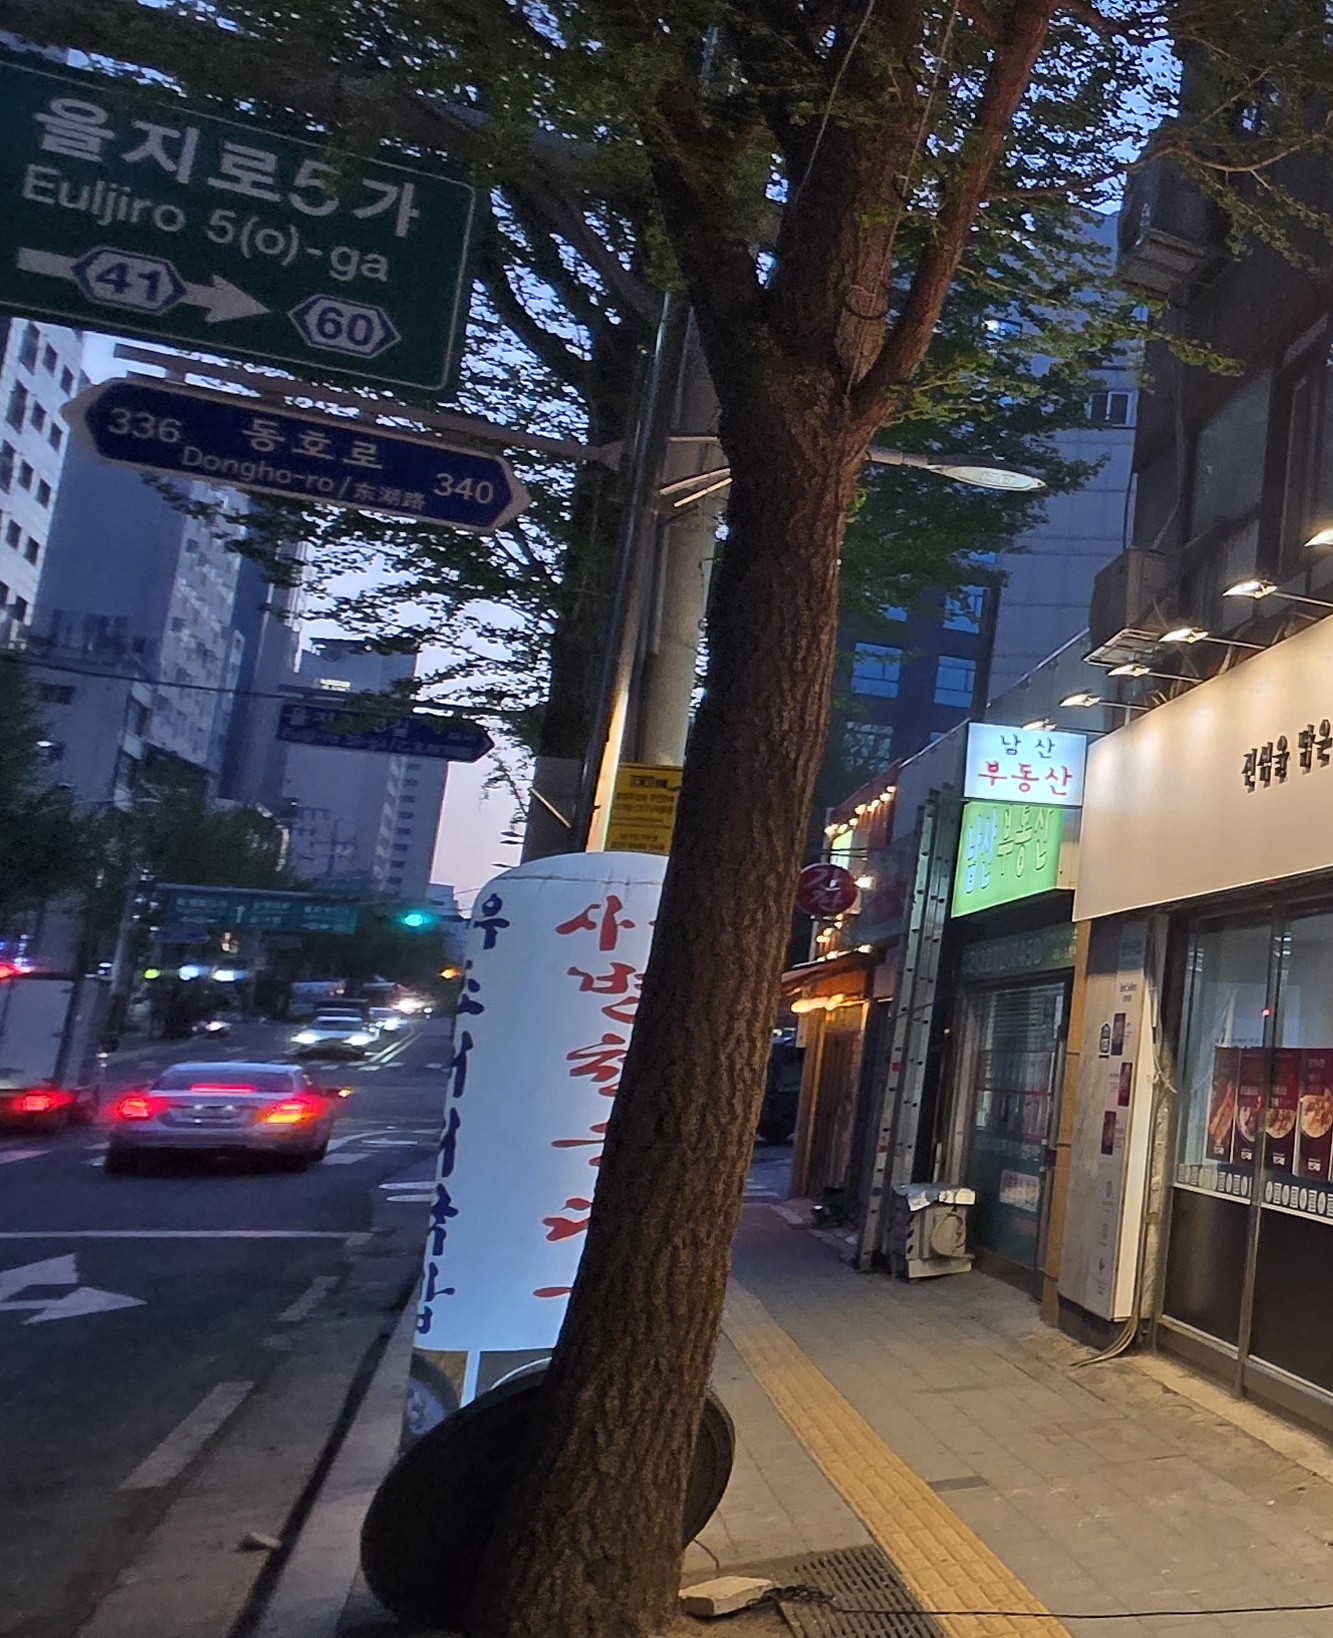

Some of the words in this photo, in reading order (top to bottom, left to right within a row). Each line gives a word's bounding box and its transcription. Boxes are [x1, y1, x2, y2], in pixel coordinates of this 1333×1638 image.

[35, 98, 420, 238] 을지로5가
[22, 163, 186, 233] Euljiro
[206, 211, 390, 283] 5(o)-ga
[96, 263, 163, 294] 41
[315, 311, 374, 346] 60
[107, 407, 181, 444] 336
[242, 417, 383, 470] 동호로
[433, 472, 495, 505] 340
[1298, 719, 1333, 770] 담은
[978, 760, 1073, 796] 부동산
